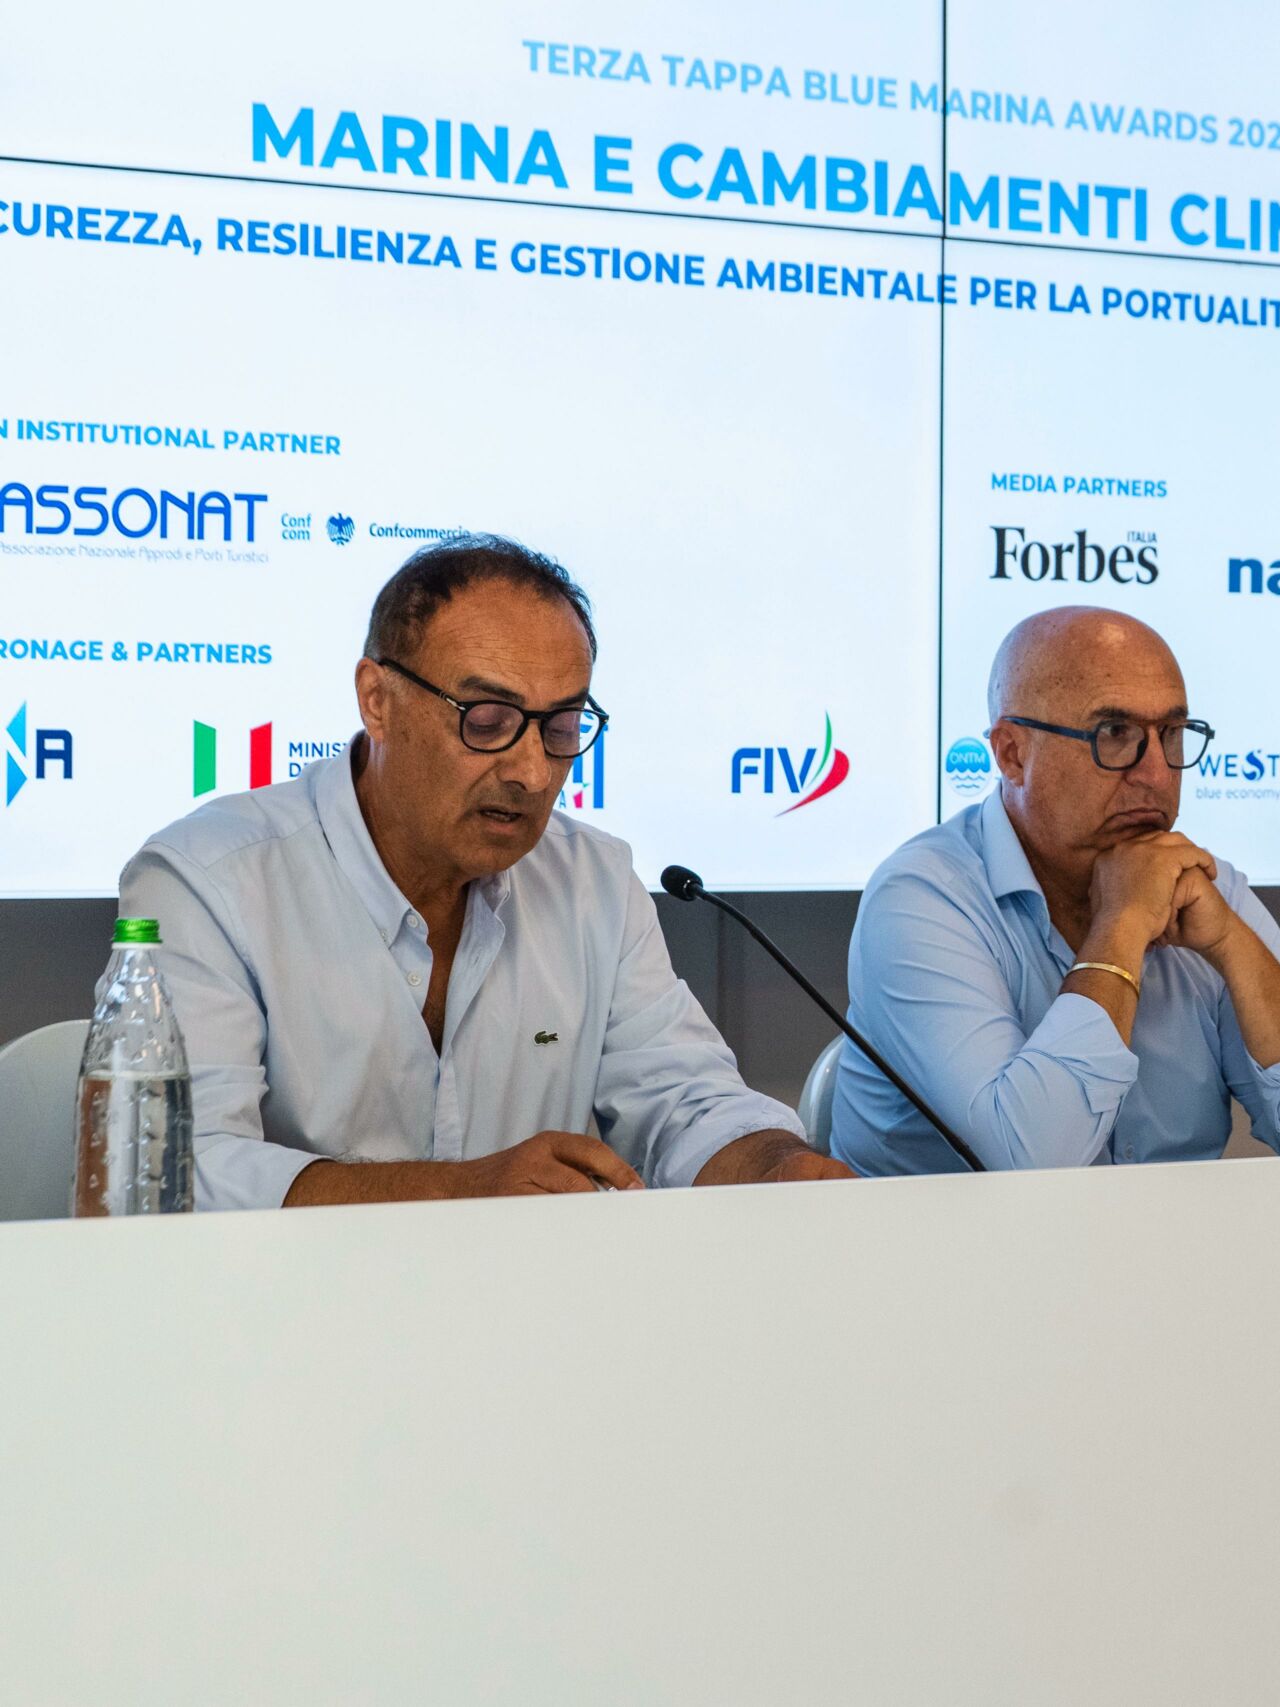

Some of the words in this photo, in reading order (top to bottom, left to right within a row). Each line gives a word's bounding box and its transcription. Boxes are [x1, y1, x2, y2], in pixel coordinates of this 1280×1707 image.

[521, 40, 652, 84] TERZA
[661, 54, 792, 98] TAPPA
[803, 70, 898, 108] BLUE
[911, 83, 1054, 129] MARINA
[1064, 102, 1219, 145] AWARDS
[251, 103, 569, 189] MARINA
[593, 135, 633, 195] E
[657, 142, 1148, 242] CAMBIAMENTI
[217, 217, 463, 269] RESILIENZA
[475, 239, 498, 271] E
[510, 241, 705, 287] GESTIONE
[716, 257, 958, 305] AMBIENTALE
[970, 276, 1037, 311] PER
[1048, 282, 1092, 315] LA
[17, 418, 216, 449] INSTITUTIONAL
[223, 430, 341, 456] PARTNER
[991, 473, 1057, 493] MEDIA
[1063, 476, 1168, 498] PARTNERS
[0, 482, 269, 543] ASSONAT
[281, 512, 312, 528] Conf
[281, 529, 311, 541] com
[1127, 531, 1158, 544] ITALIA
[78, 544, 136, 559] Nazionale
[186, 551, 193, 561] e
[990, 526, 1159, 585] Forbes
[111, 641, 129, 662] &
[136, 642, 273, 665] PARTNERS
[288, 741, 346, 758] MINIS
[731, 747, 818, 794] FIV
[1225, 789, 1280, 801] economy
